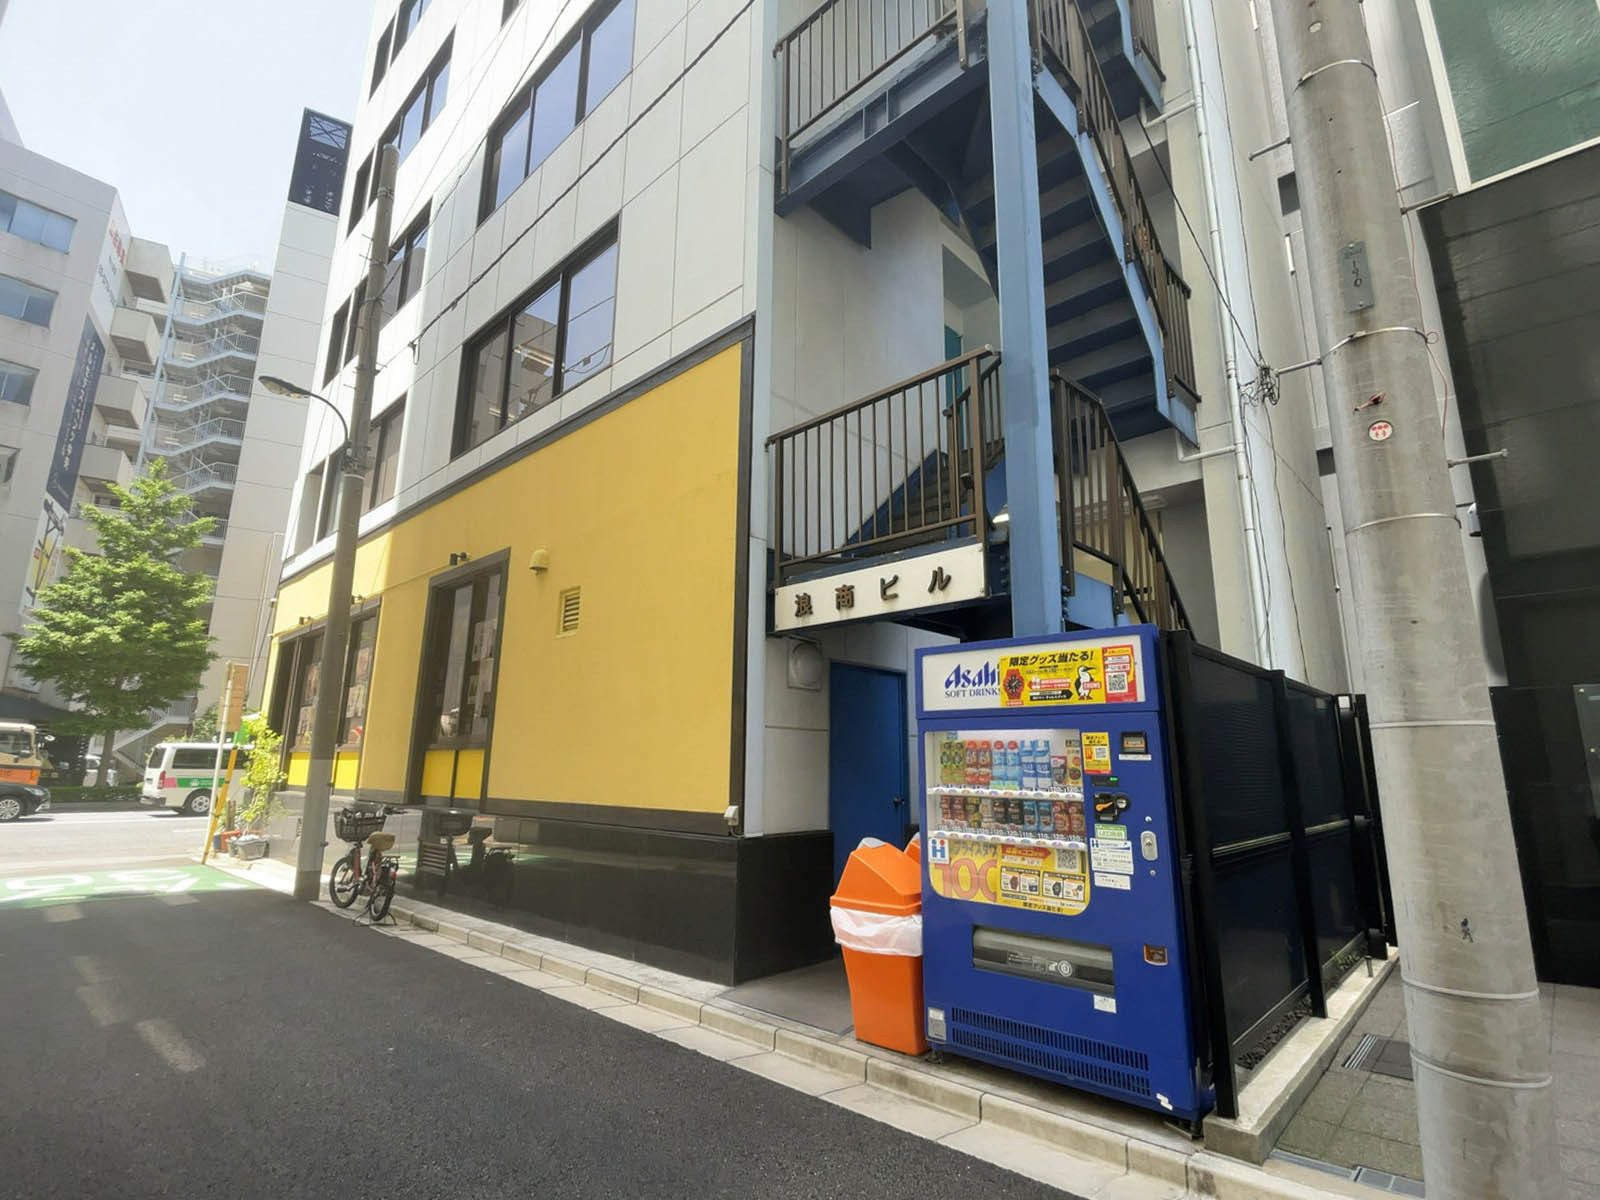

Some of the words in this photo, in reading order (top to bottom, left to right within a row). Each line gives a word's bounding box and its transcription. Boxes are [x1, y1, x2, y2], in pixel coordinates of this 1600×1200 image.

[795, 566, 952, 617] 浪商ビル
[945, 689, 967, 699] SOFT
